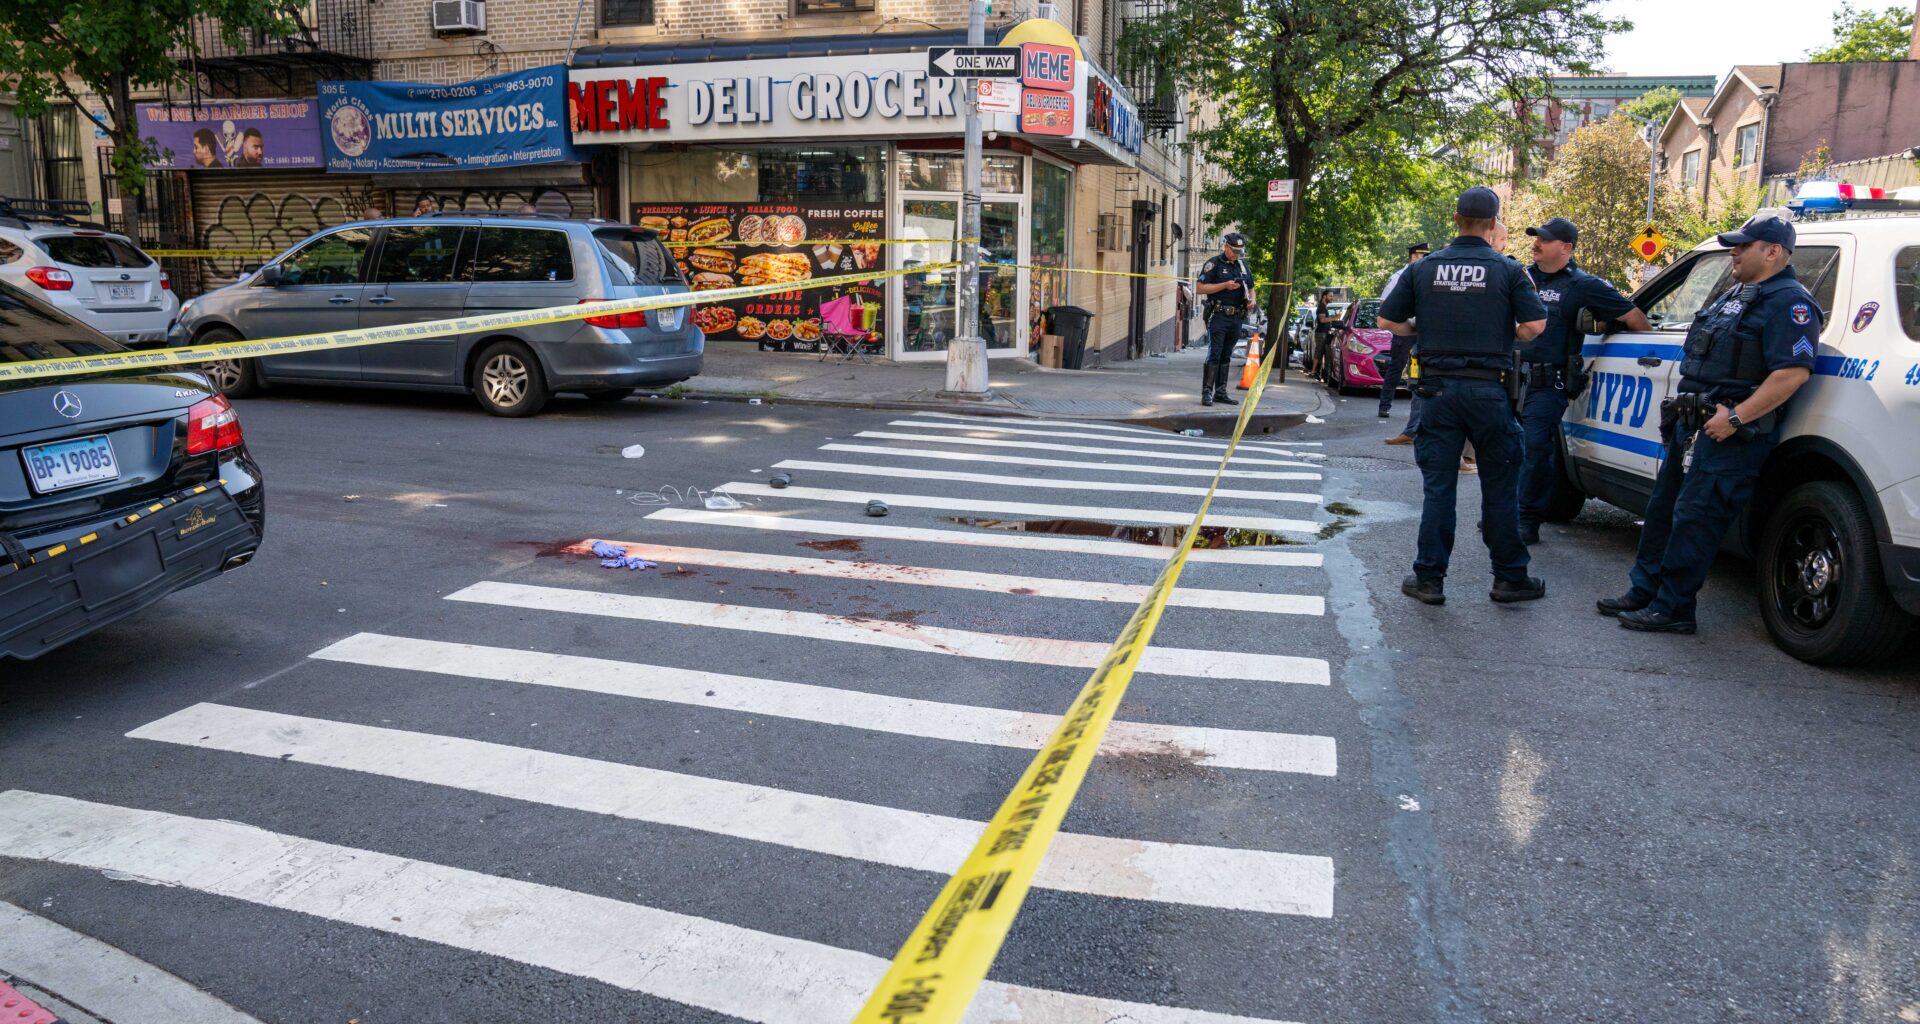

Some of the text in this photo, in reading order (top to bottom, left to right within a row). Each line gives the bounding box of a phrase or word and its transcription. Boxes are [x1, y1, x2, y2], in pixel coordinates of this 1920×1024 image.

[956, 56, 1012, 68] ONE WAY
[1026, 50, 1070, 82] MEME
[322, 85, 337, 94] 305
[212, 104, 268, 121] BARBER
[270, 103, 309, 118] SHOP
[324, 96, 374, 121] World Class
[568, 77, 671, 133] MEME
[687, 76, 773, 125] DELI
[1043, 95, 1069, 111] GROCERIES
[375, 111, 438, 140] MULTI
[441, 102, 544, 137] SERVICES
[332, 158, 352, 170] Realty
[355, 158, 377, 170] Notary
[467, 153, 508, 166] Immigration
[513, 147, 561, 161] Interpretation
[699, 206, 728, 214] LUNCH
[747, 206, 773, 214] HALAL
[776, 206, 798, 214] FOOD
[808, 209, 884, 218] FRESH COFFEE
[852, 221, 878, 233] Coffee
[1436, 264, 1486, 282] NYPD
[769, 291, 803, 301] SIDE
[746, 304, 800, 315] ORDERS
[1839, 357, 1880, 381] SRG 2
[1586, 371, 1653, 428] NYPD
